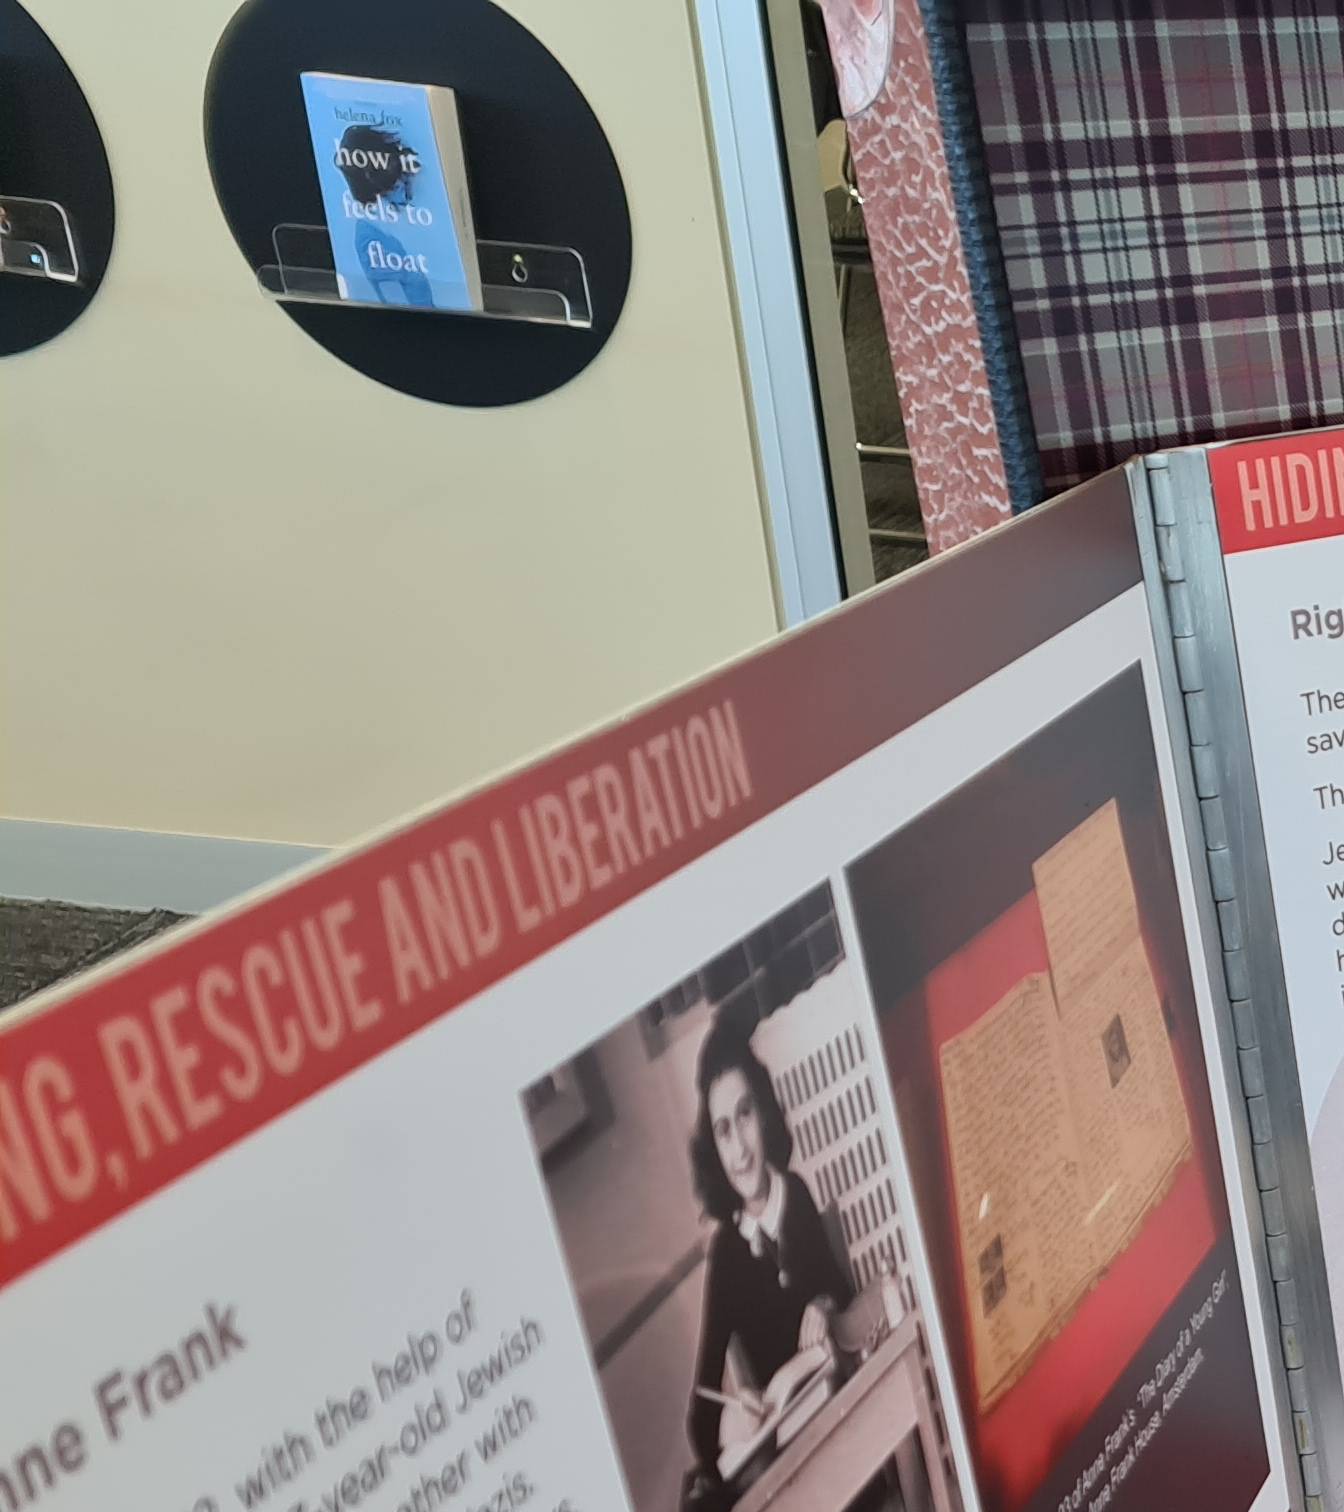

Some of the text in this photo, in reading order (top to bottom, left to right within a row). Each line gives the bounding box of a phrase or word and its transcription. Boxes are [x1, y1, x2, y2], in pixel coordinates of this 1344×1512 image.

[334, 138, 422, 174] how it
[343, 191, 433, 226] feels to
[368, 241, 429, 273] float
[98, 898, 383, 1166] RESCUE
[378, 836, 500, 1003] AND
[494, 700, 754, 935] LIBERATION
[92, 1302, 247, 1443] Frank
